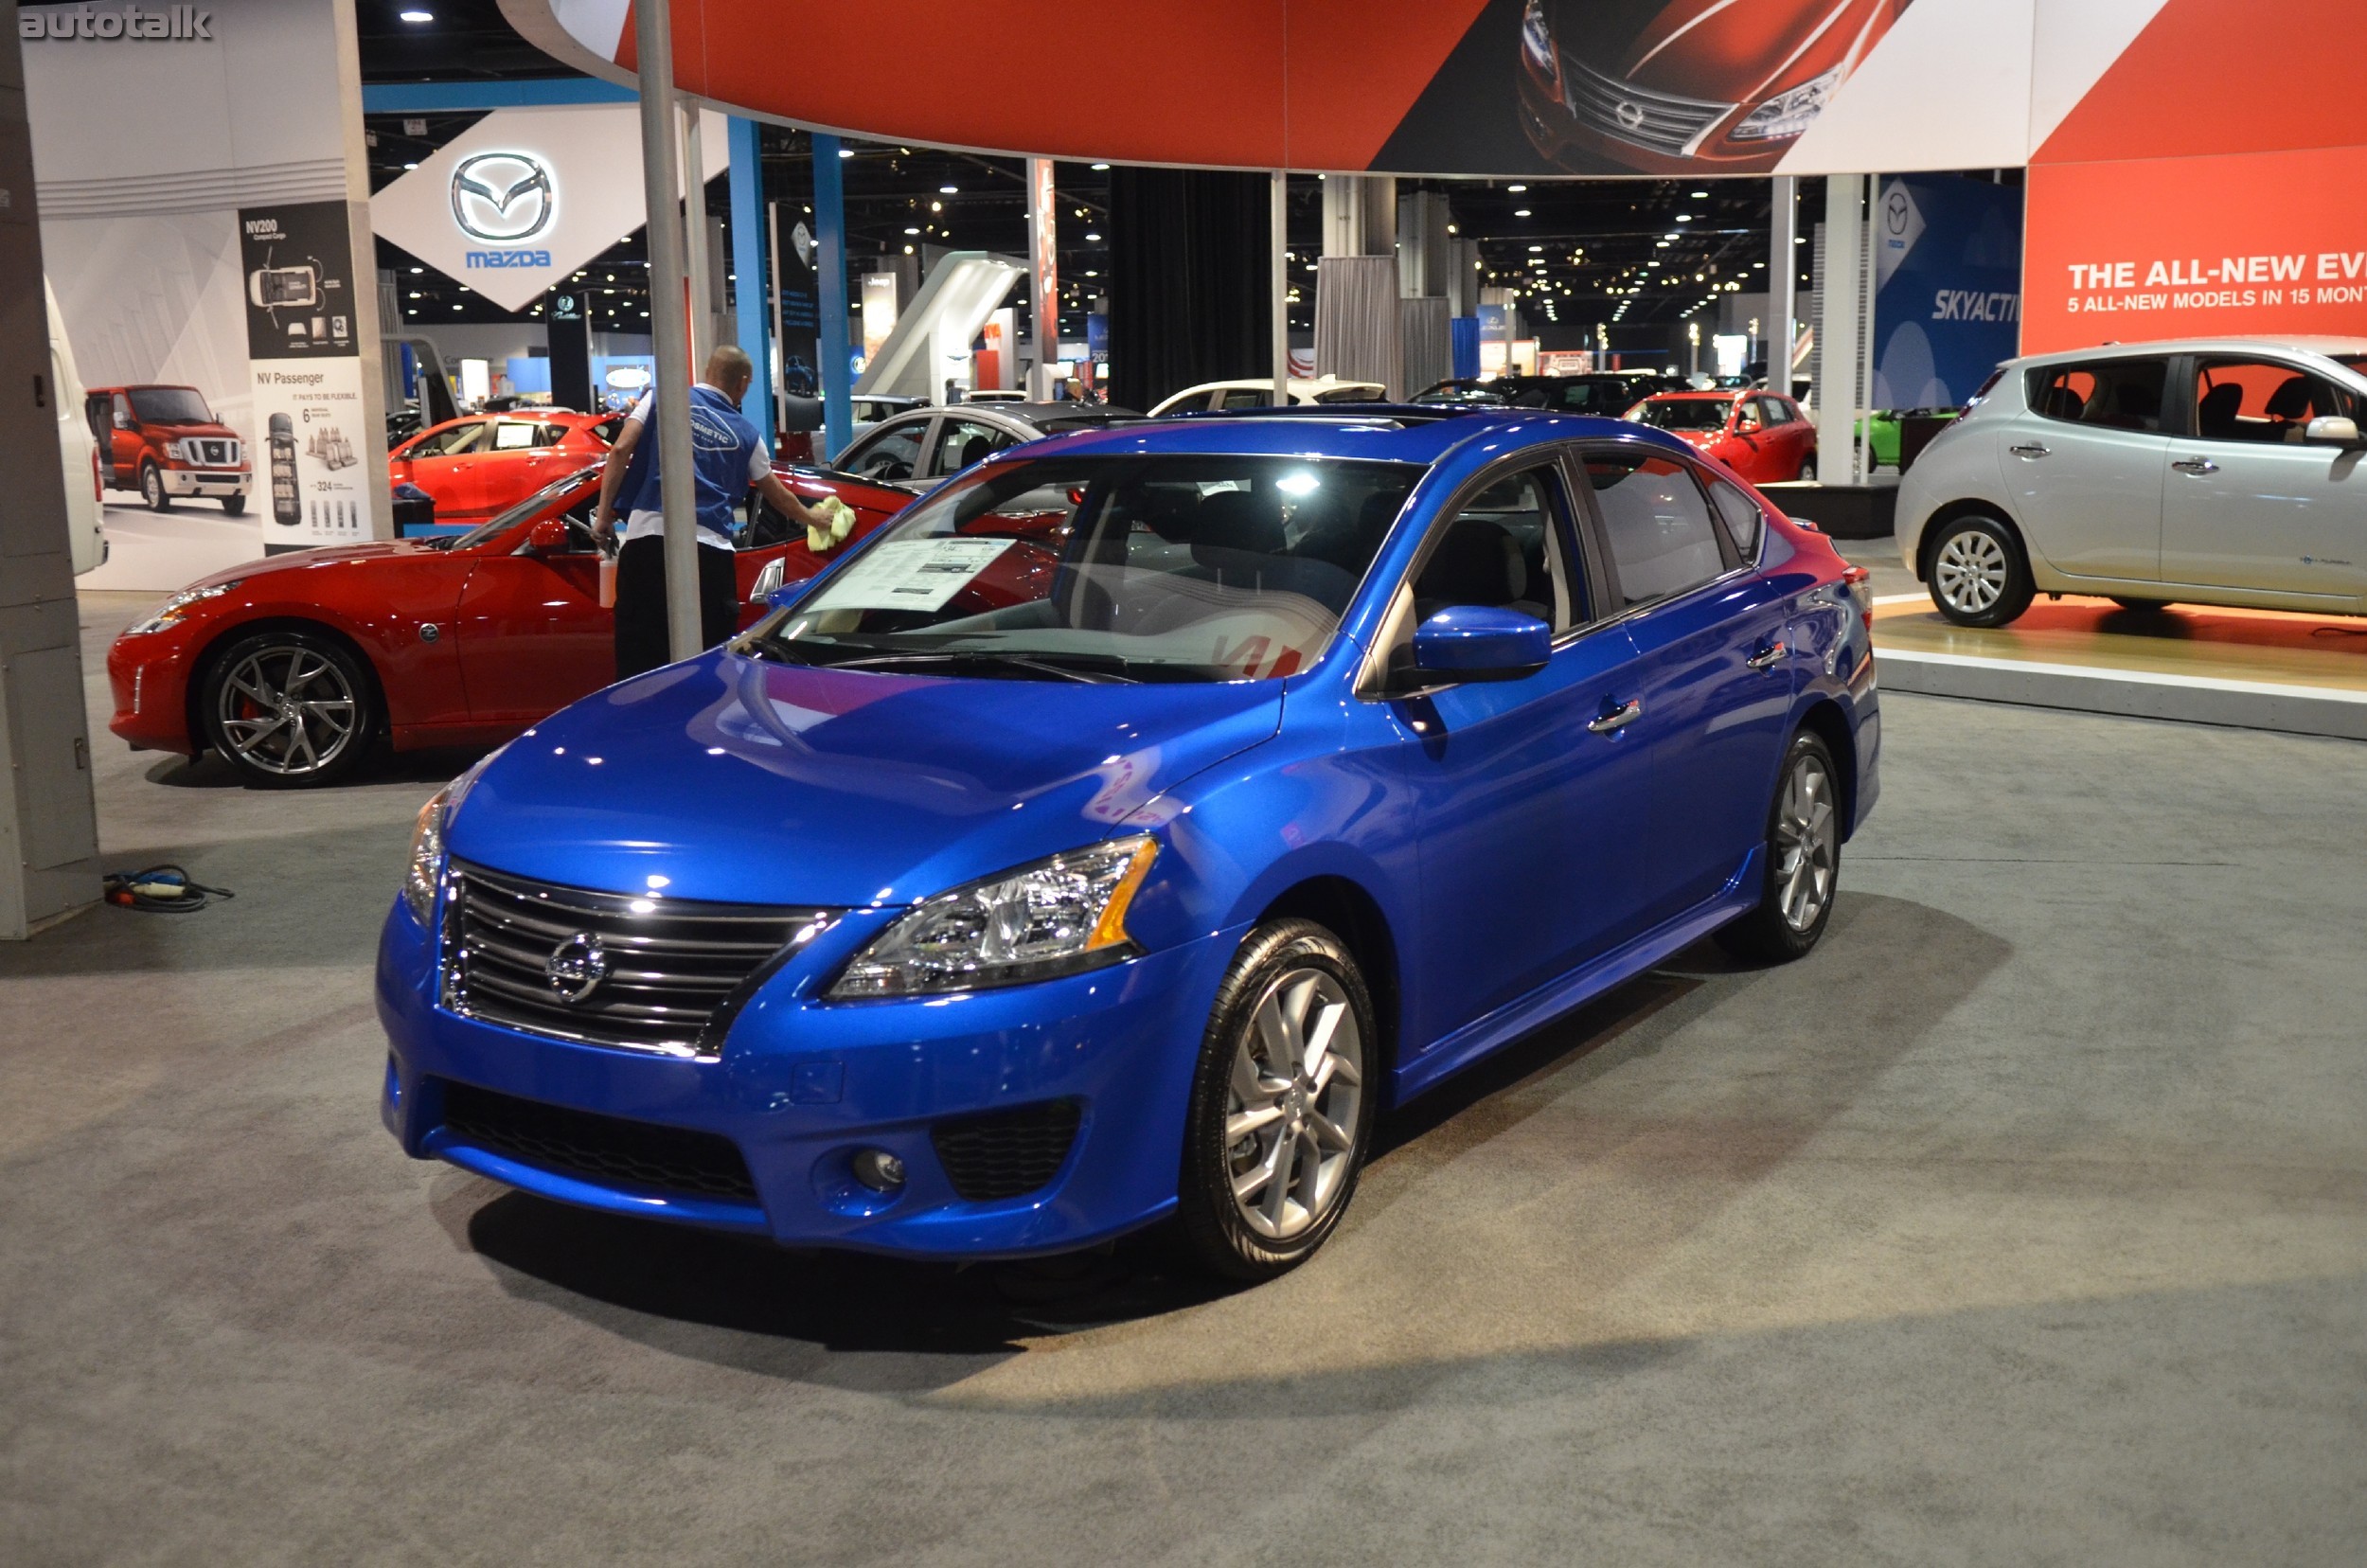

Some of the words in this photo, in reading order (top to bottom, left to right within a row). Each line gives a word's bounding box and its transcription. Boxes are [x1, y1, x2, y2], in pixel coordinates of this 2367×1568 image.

[245, 219, 278, 234] NV200
[466, 250, 552, 268] mazda
[2068, 261, 2135, 290] THE
[2145, 254, 2306, 287] ALL-NEW
[2316, 252, 2367, 279] EV
[2067, 296, 2079, 312] 5
[2083, 294, 2168, 312] ALL-NEW
[2173, 290, 2256, 310] MODELS
[2262, 289, 2283, 305] IN
[2289, 288, 2310, 304] 15
[2316, 285, 2367, 304] MON
[258, 373, 272, 384] NV
[274, 372, 324, 386] Passenger
[302, 408, 311, 423] 6
[317, 481, 332, 491] 324
